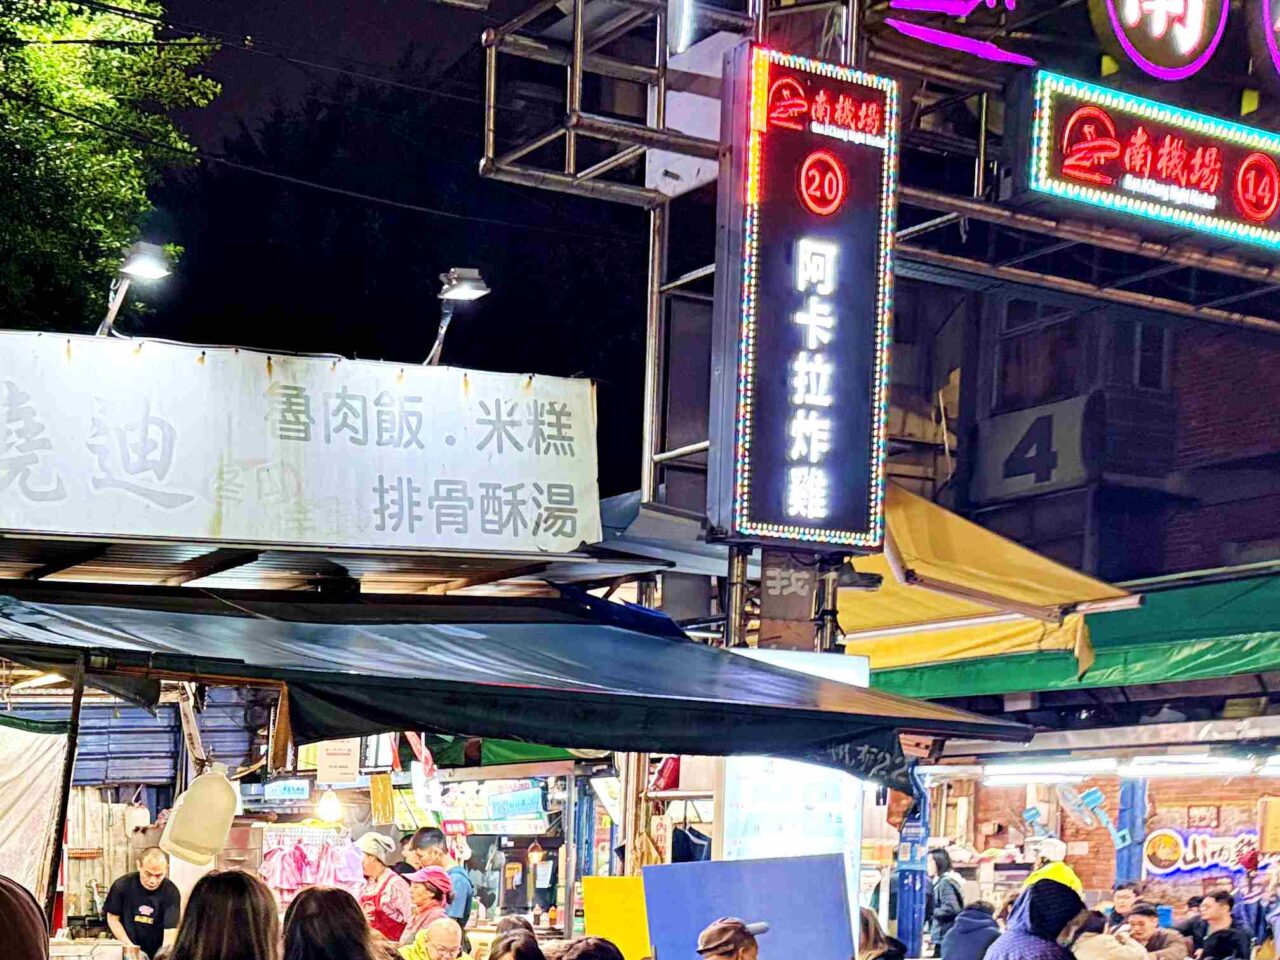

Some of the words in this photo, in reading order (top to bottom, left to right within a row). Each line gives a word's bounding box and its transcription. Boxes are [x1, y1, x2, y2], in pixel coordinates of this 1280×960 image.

[811, 90, 880, 135] 南機場
[1123, 126, 1222, 193] 南機場
[1003, 415, 1059, 485] 4
[372, 474, 579, 538] 排骨酥湯
